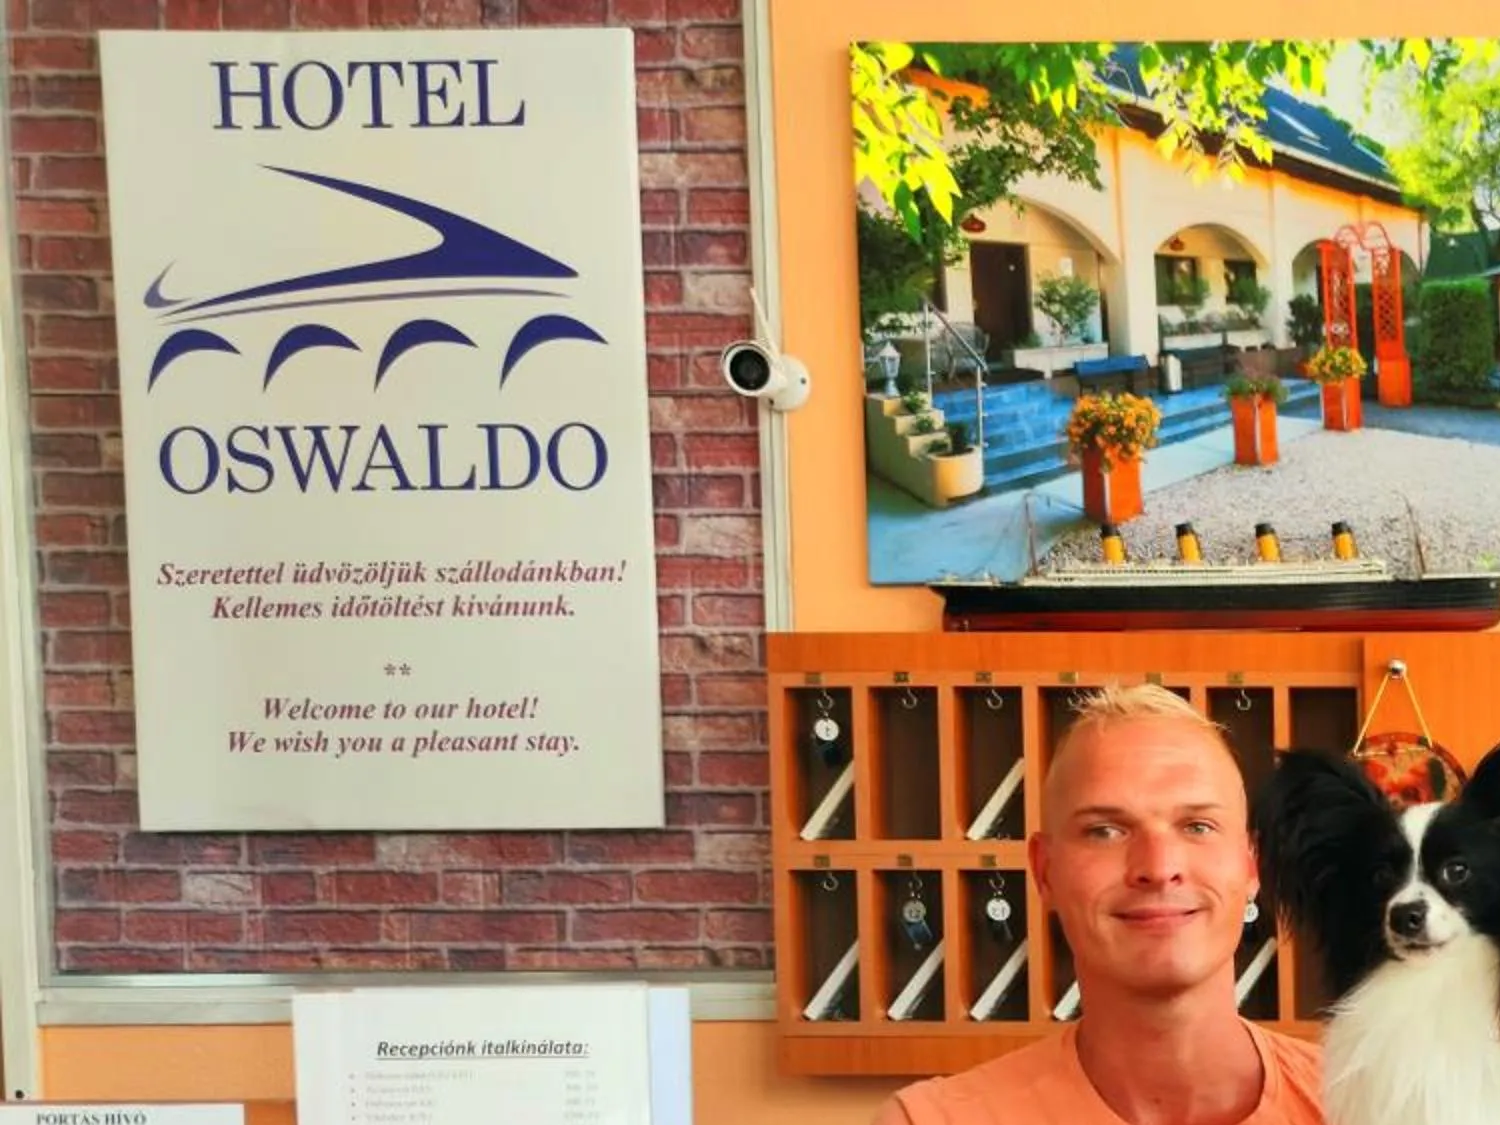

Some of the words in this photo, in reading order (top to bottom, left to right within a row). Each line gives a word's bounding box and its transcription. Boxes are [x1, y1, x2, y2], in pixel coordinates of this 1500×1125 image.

[209, 59, 525, 131] HOTEL
[158, 421, 609, 494] OSWALDO
[156, 561, 286, 588] Szeretettel
[292, 560, 427, 589] üdvözöljük
[434, 559, 627, 585] szállodánkban!
[211, 595, 323, 619] Kellemes
[330, 594, 445, 619] időtöltést
[263, 696, 377, 721] Welcome
[382, 700, 408, 720] to
[414, 701, 460, 720] our
[465, 695, 540, 720] hotel!
[227, 730, 267, 753] We
[273, 730, 329, 753] wish
[334, 735, 383, 760] you
[390, 735, 407, 752] a
[411, 728, 519, 759] pleasant
[525, 731, 580, 758] stay.
[376, 1039, 476, 1059] Recepciónk
